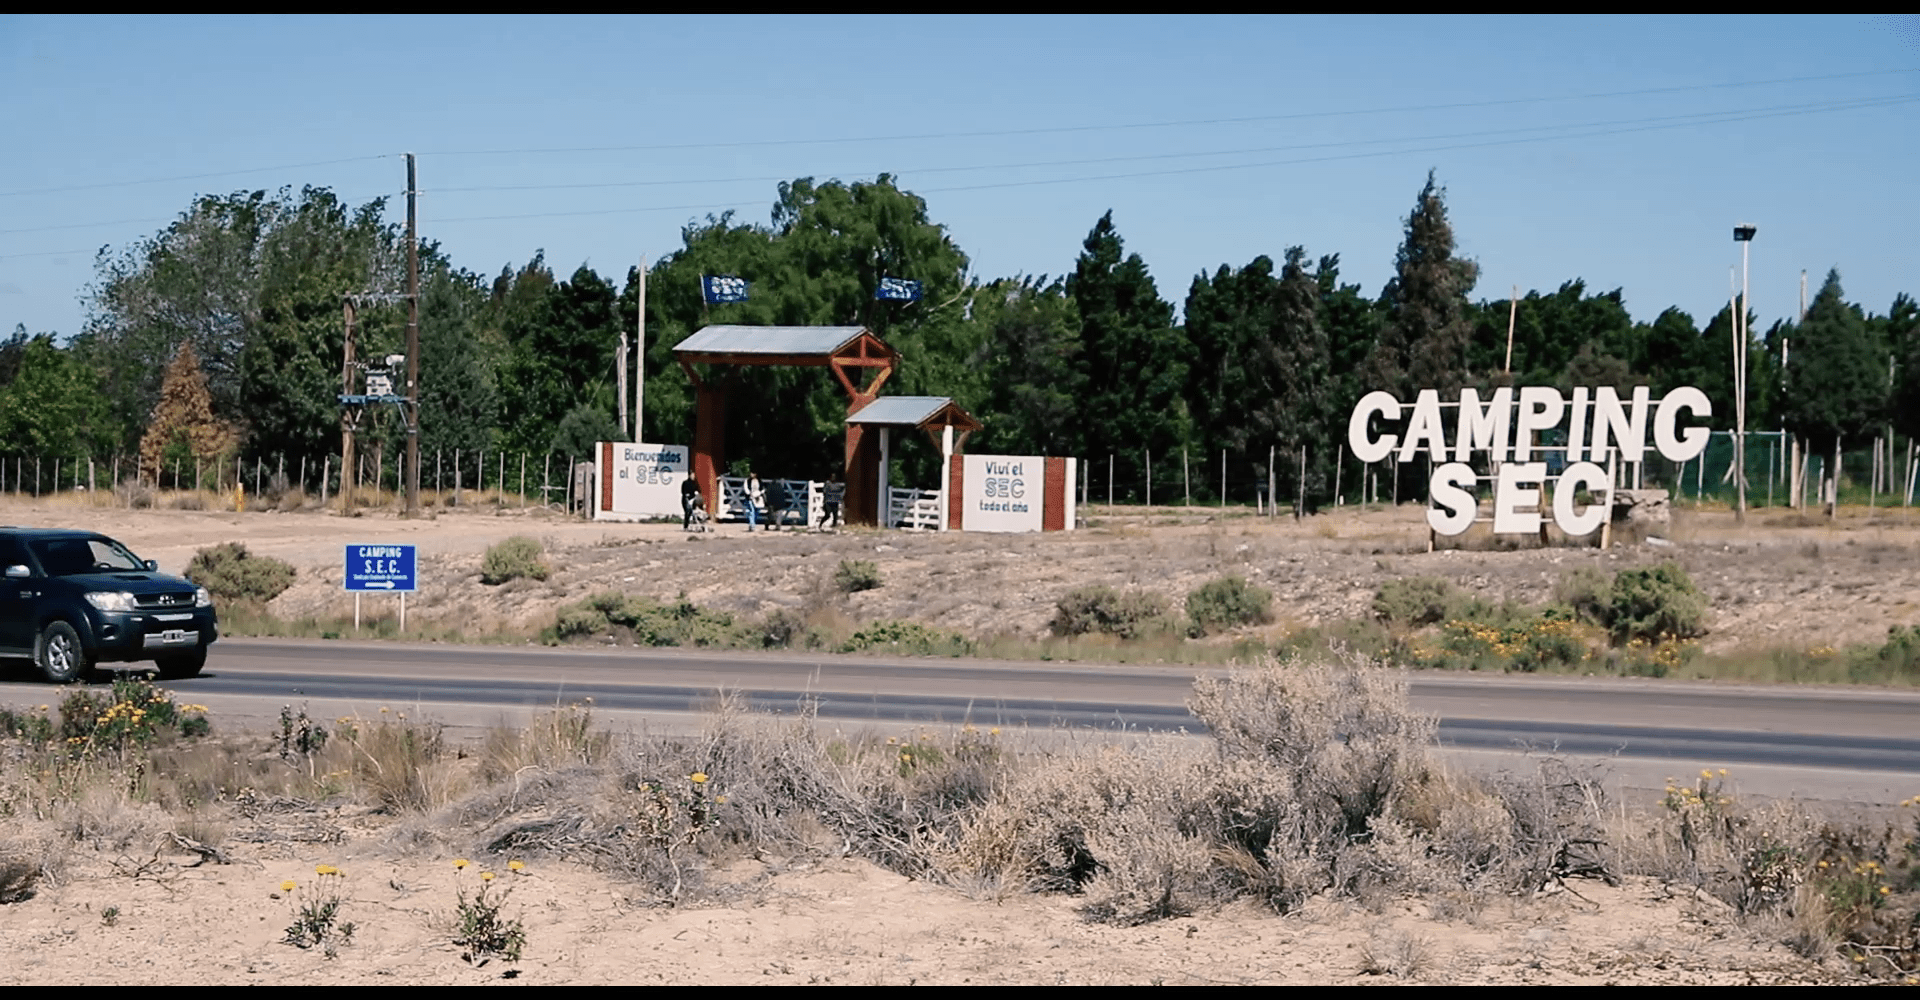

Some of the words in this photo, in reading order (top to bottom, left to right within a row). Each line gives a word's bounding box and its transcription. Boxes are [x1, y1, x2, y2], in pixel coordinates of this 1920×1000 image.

[1349, 386, 1712, 463] CAMPING
[619, 466, 629, 479] al
[636, 465, 673, 485] SEC
[1012, 462, 1023, 475] el
[984, 477, 1025, 498] SEC
[979, 499, 1000, 511] todo
[1002, 501, 1011, 512] el
[1426, 461, 1609, 536] SEC
[359, 546, 402, 558] CAMPING
[364, 559, 400, 574] S.E.C.
